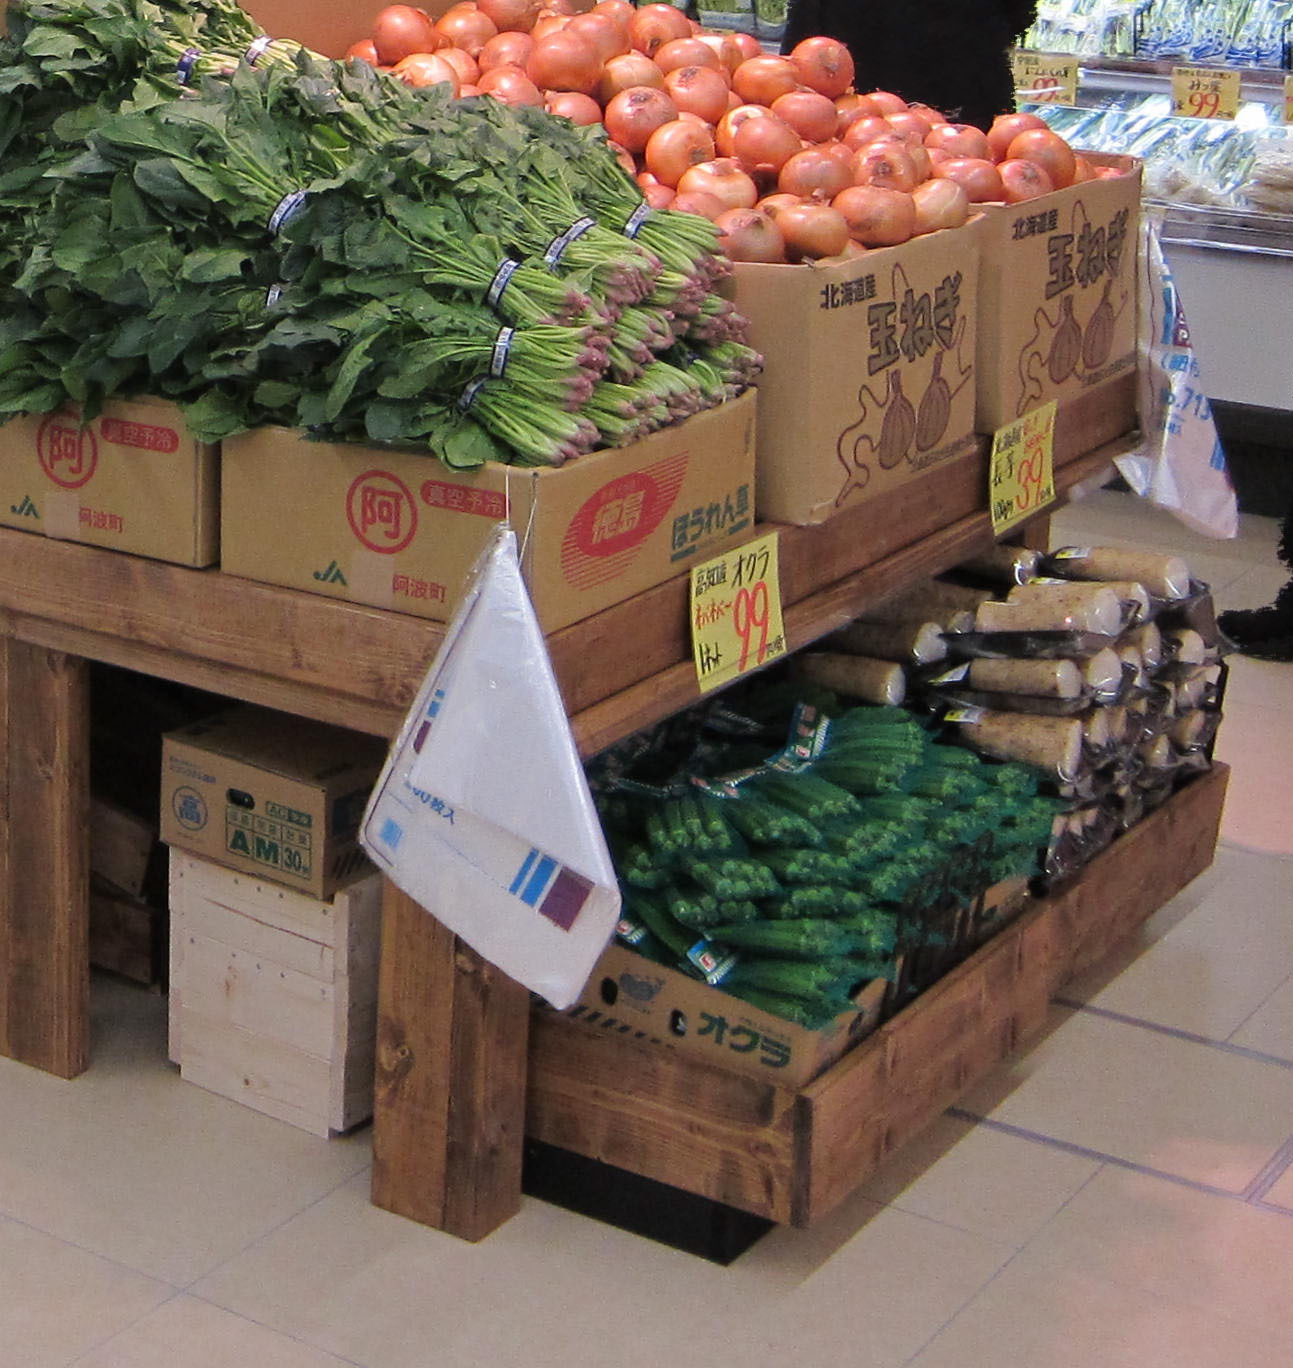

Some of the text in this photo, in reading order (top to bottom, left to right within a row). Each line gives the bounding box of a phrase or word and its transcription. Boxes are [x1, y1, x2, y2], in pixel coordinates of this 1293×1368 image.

[1032, 79, 1059, 101] 99
[1188, 93, 1220, 118] 99
[1011, 208, 1060, 241] 北海道産
[1045, 206, 1131, 300] 玉ねぎ
[820, 274, 877, 311] 北海道産
[866, 269, 964, 378] 玉ねぎ
[49, 426, 83, 474] 阿
[429, 484, 504, 516] 真空予冷
[1015, 446, 1043, 510] 39
[361, 486, 403, 539] 阿
[672, 484, 749, 551] ほうれん草
[392, 573, 447, 603] 阿波町
[731, 545, 769, 589] オクラ
[734, 582, 769, 672] 99
[230, 829, 250, 855] A
[255, 837, 279, 864] M
[697, 1012, 791, 1069] オクラ
